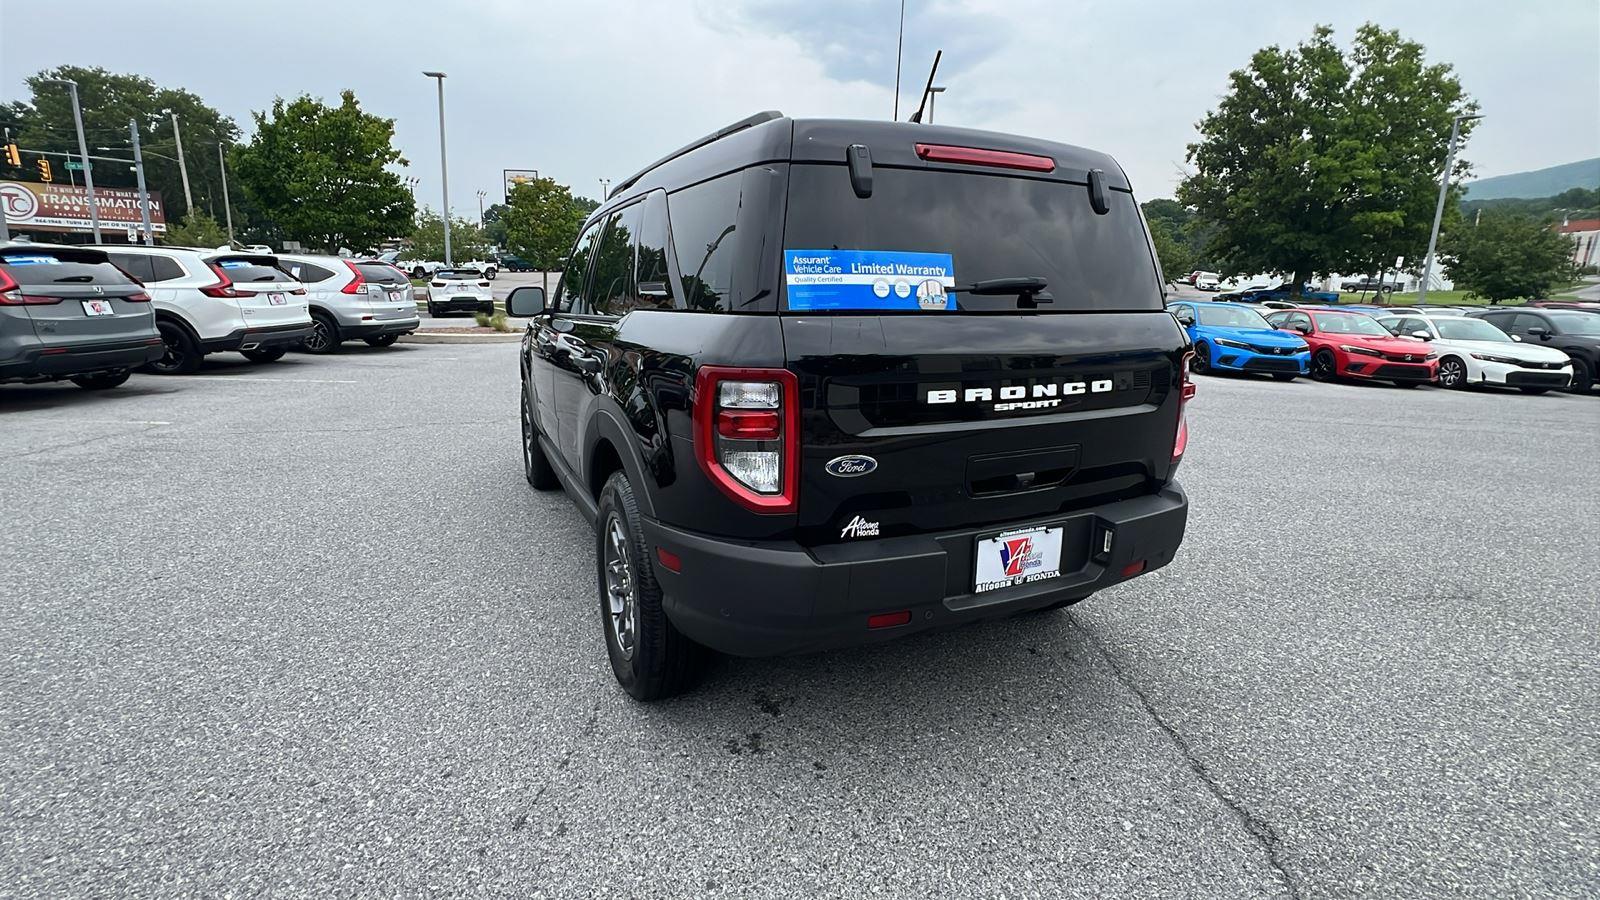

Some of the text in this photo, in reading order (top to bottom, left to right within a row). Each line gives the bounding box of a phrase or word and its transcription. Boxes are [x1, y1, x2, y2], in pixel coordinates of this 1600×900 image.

[793, 256, 830, 265] Assurant
[793, 264, 842, 274] Vehicle Care
[851, 262, 946, 277] Limited Warranty
[794, 276, 816, 284] Quality
[927, 379, 1113, 404] BRONCO
[993, 399, 1062, 412] SPORT
[838, 460, 867, 473] Ford
[857, 529, 880, 537] Honda
[975, 570, 1061, 594] Altoona HONDA
